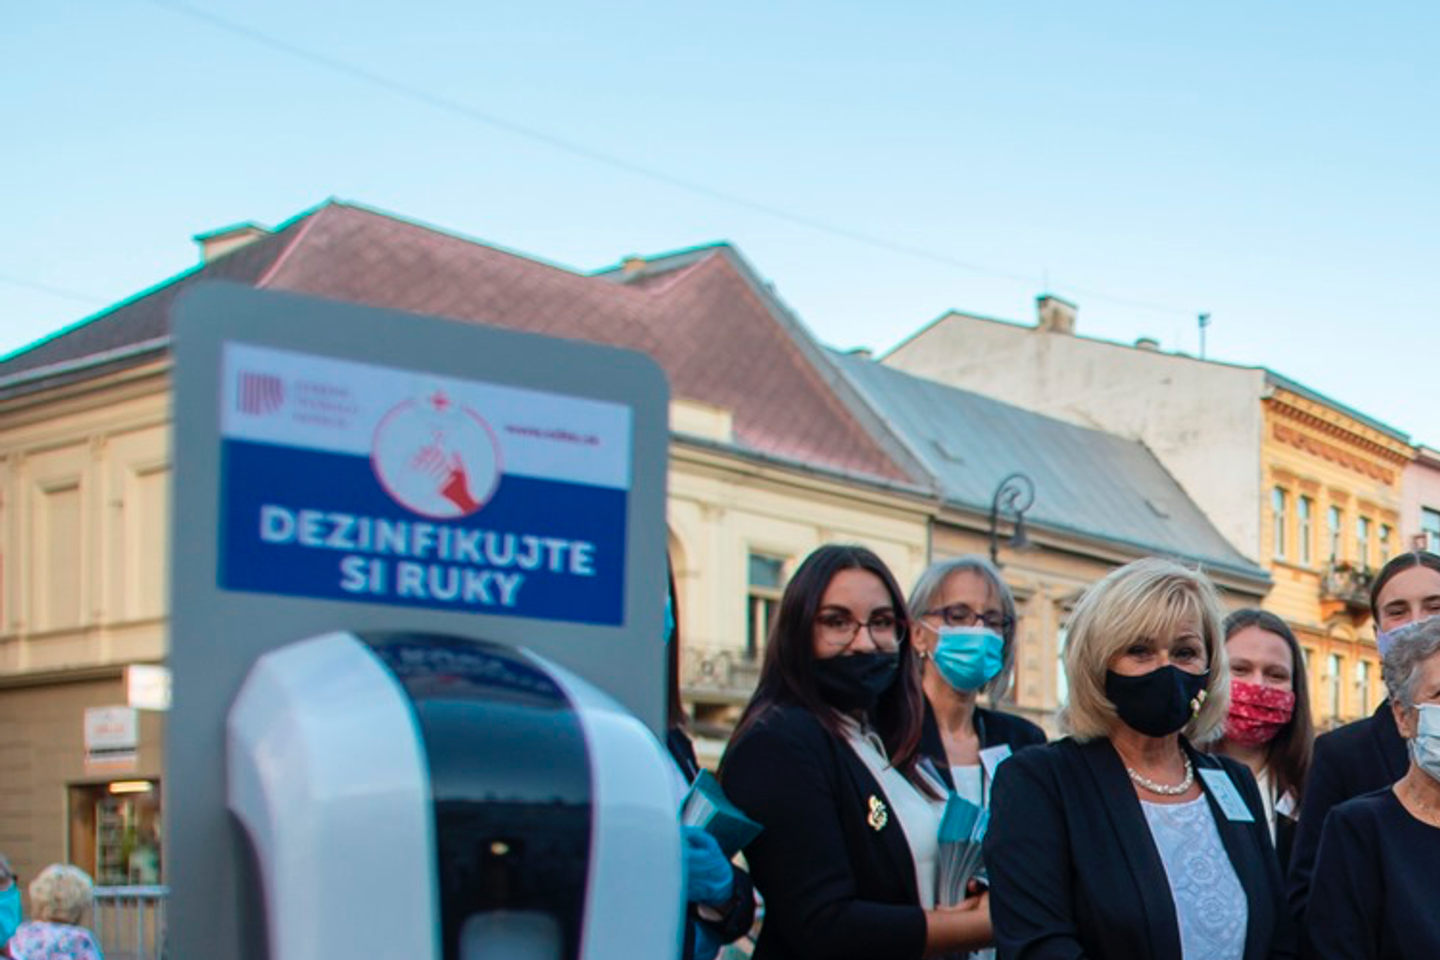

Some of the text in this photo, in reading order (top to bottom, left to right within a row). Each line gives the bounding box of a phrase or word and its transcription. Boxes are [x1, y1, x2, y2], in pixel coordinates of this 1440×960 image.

[259, 504, 597, 577] DEZINFIKUJTE
[339, 554, 525, 607] SI RUKY
